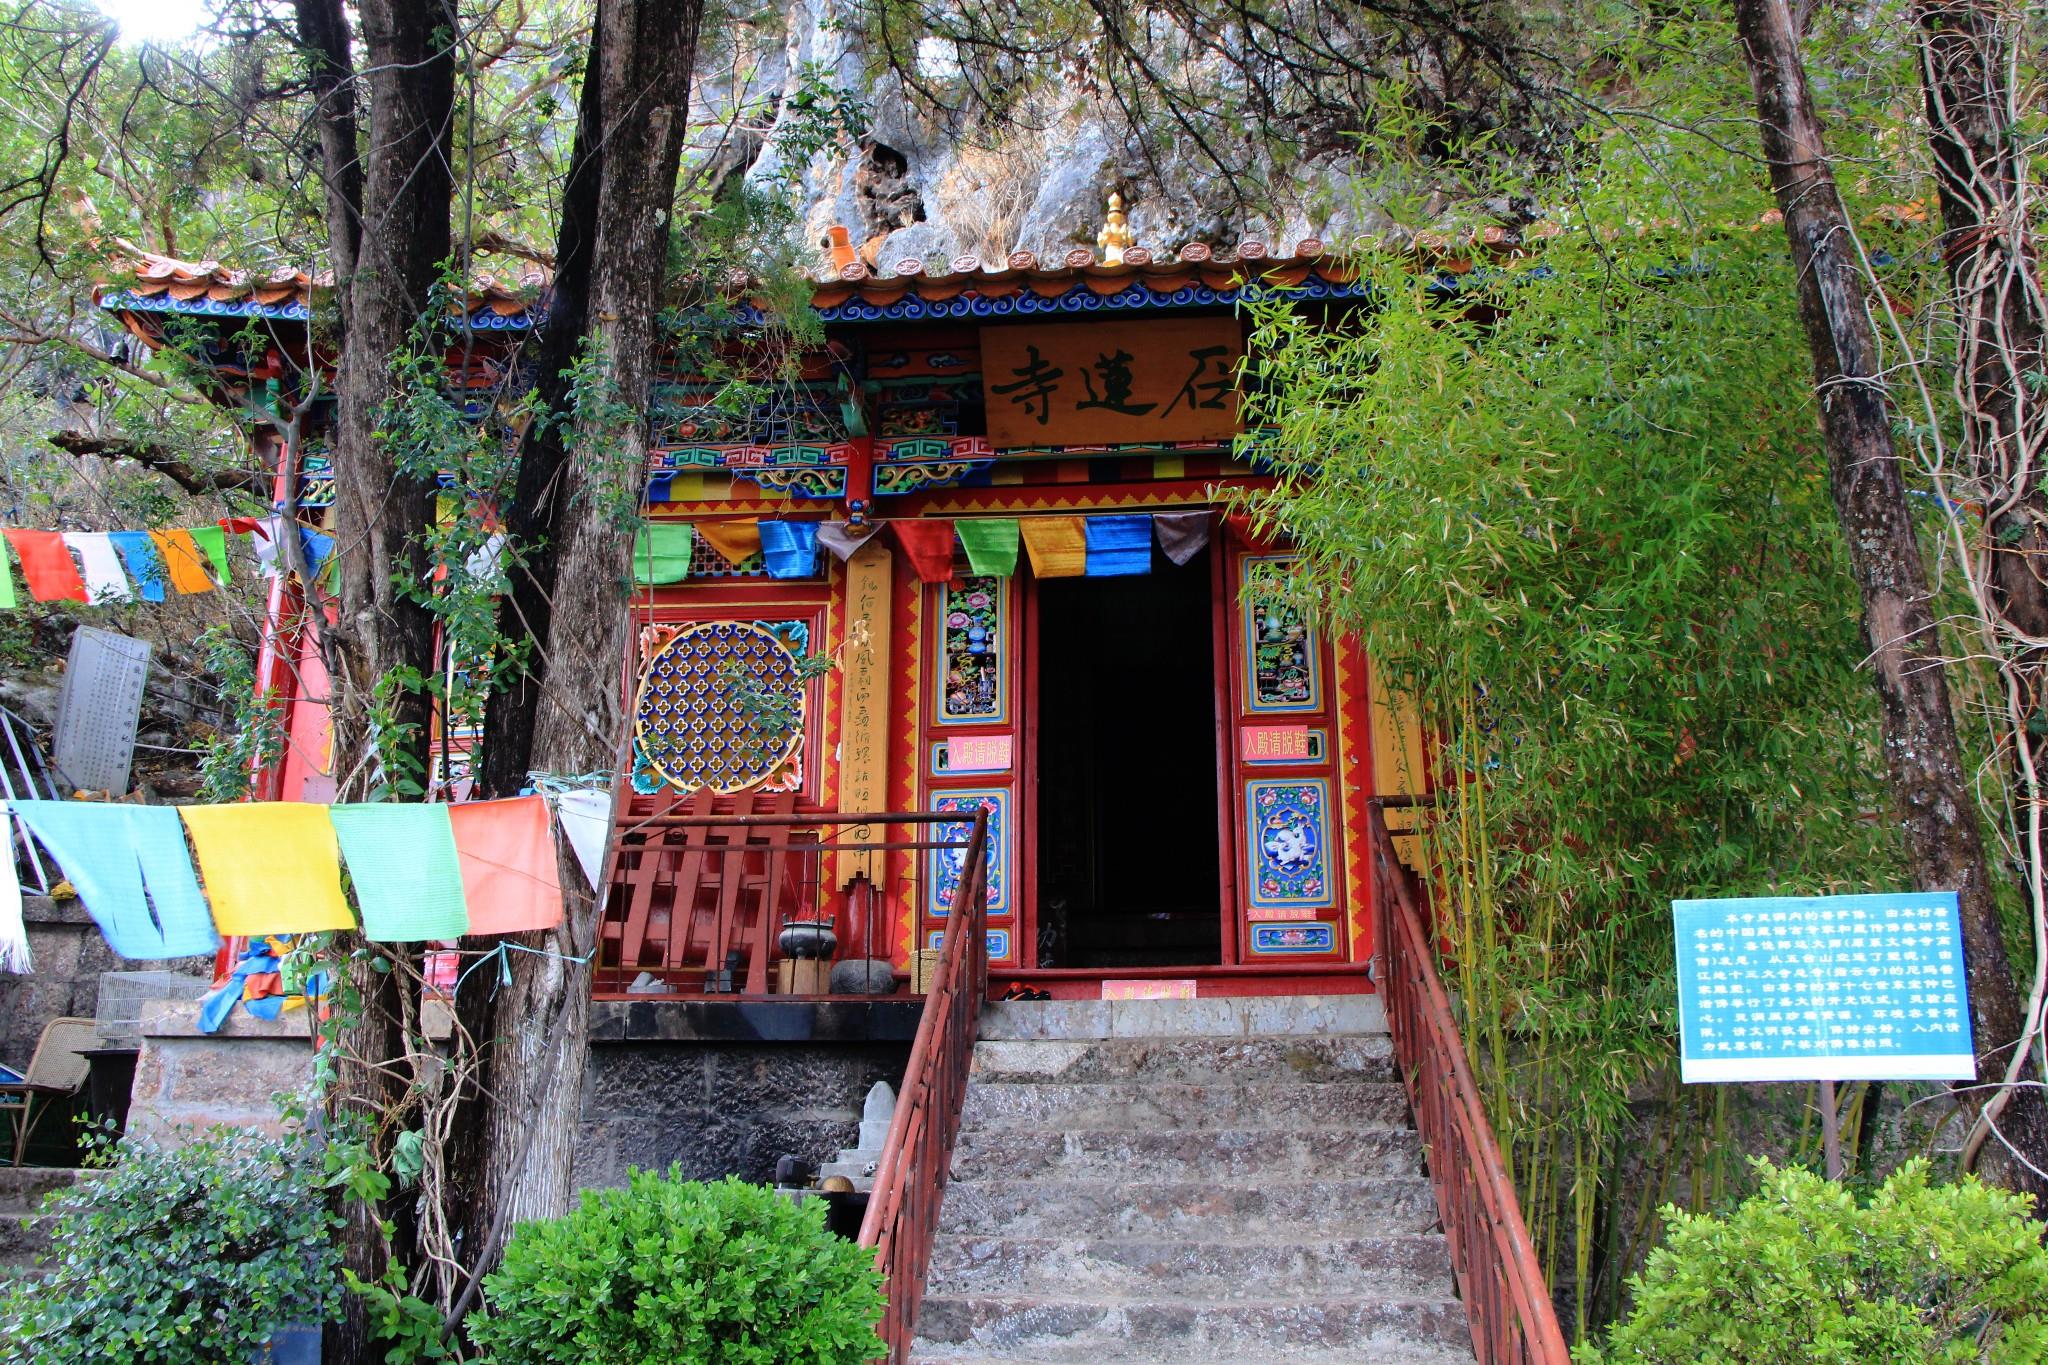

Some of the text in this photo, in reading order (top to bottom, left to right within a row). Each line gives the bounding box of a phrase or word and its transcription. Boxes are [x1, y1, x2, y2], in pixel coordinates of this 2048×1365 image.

[950, 739, 1009, 767] 入殿请脱鞋
[1245, 731, 1307, 756] 入殿请脱鞋
